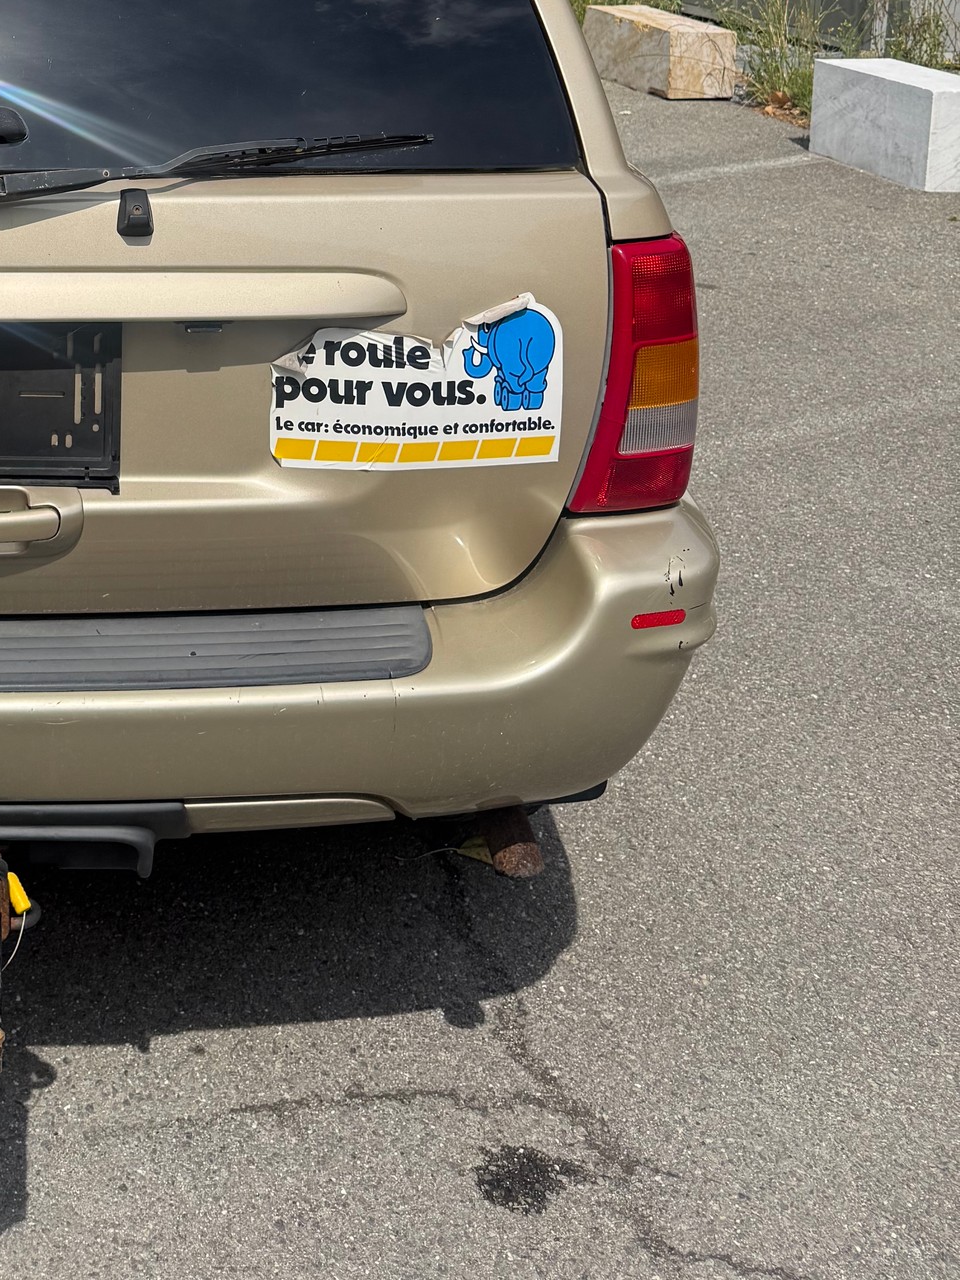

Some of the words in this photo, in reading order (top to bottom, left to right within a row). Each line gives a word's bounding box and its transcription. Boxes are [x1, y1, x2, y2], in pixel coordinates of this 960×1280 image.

[323, 336, 431, 370] roule
[275, 376, 374, 408] pour
[381, 380, 487, 407] vous.
[297, 421, 329, 433] car:
[332, 419, 439, 439] économique
[442, 422, 459, 435] et
[462, 416, 555, 434] confortable.
